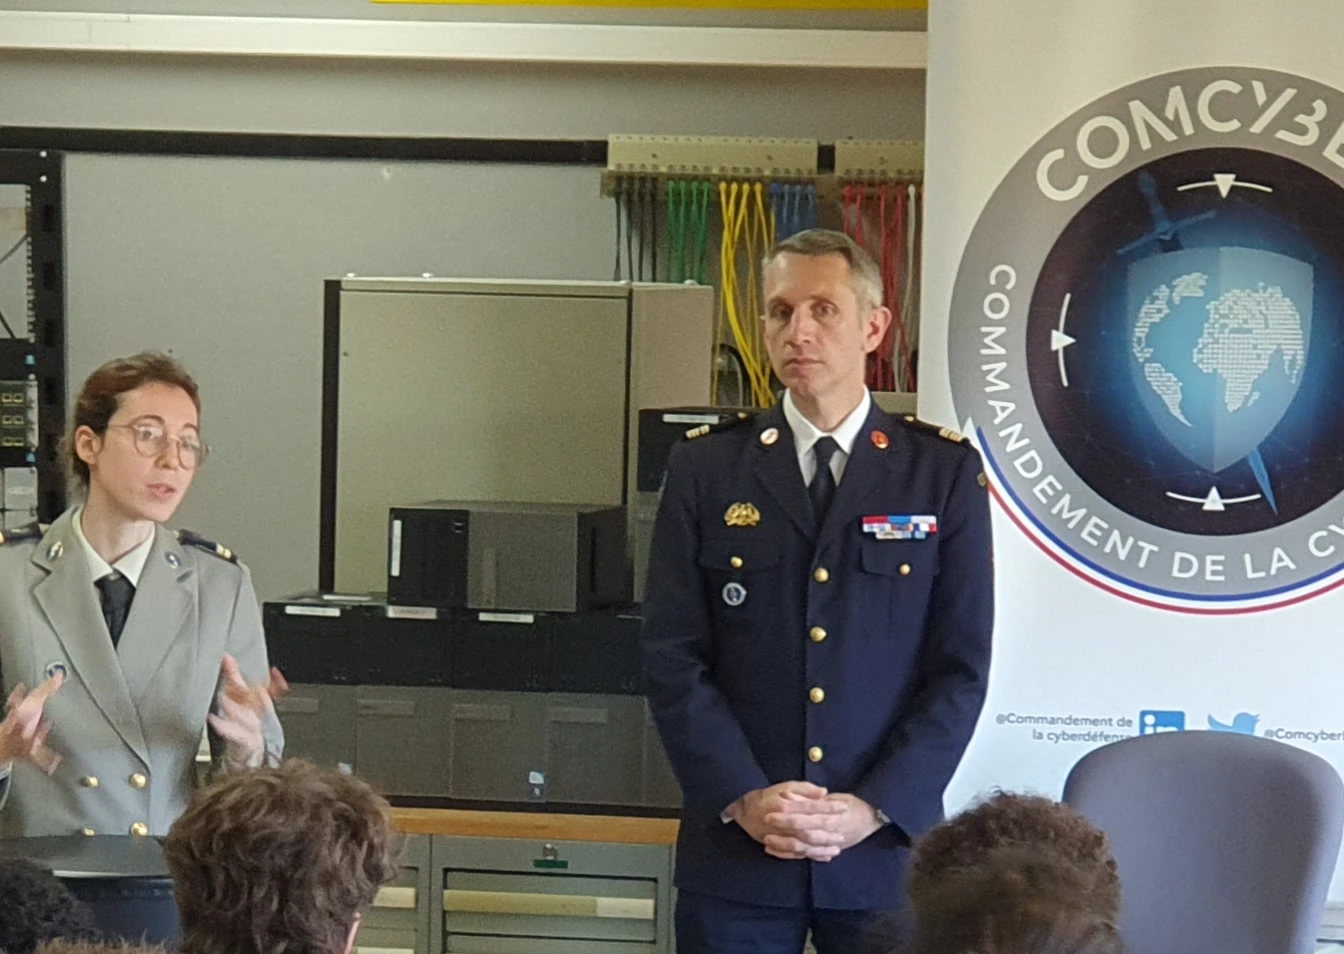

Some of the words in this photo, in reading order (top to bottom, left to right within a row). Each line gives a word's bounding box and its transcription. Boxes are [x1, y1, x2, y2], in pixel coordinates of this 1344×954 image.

[979, 263, 1159, 569] COMMANDEMENT
[1170, 551, 1226, 581] DE
[1244, 546, 1297, 579] LA
[995, 711, 1114, 728] @Commandement
[1116, 716, 1133, 728] de
[1032, 728, 1043, 741] la
